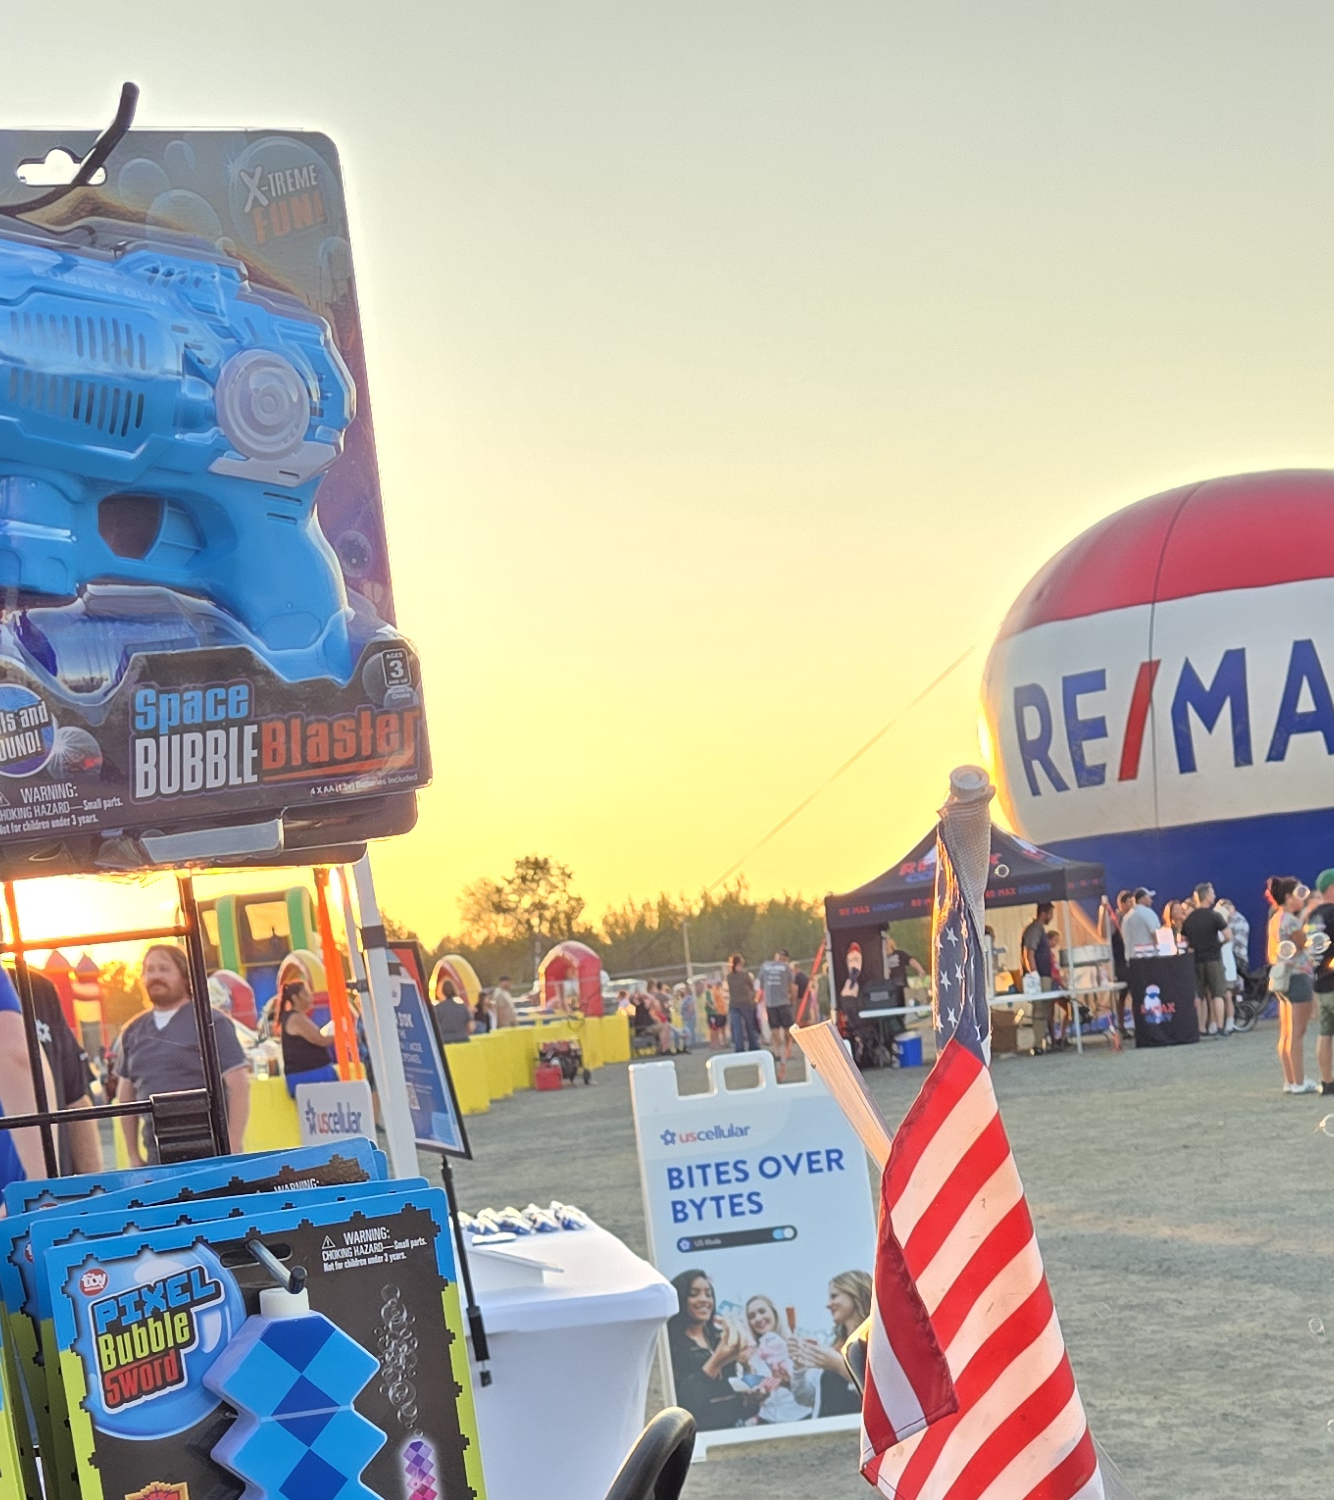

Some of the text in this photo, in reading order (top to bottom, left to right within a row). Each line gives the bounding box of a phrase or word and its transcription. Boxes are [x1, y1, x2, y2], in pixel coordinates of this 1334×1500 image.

[240, 165, 317, 212] X-TREME
[252, 191, 324, 246] FUN!
[390, 660, 404, 678] 3
[20, 701, 49, 728] and
[135, 684, 249, 735] Space
[20, 782, 78, 803] WARNING:
[324, 785, 335, 793] AA
[103, 797, 123, 810] parts.
[11, 821, 21, 832] for
[23, 817, 50, 831] children
[51, 815, 70, 828] under
[72, 815, 76, 825] 3
[78, 814, 99, 826] years.
[679, 1123, 751, 1144] uscellular
[666, 1148, 845, 1191] BITES OVER
[671, 1190, 764, 1224] BYTES
[343, 1226, 390, 1245] WARNING:
[322, 1237, 427, 1262] CHOKING parts.
[324, 1252, 406, 1272] Not for children under 3 years.
[81, 1274, 106, 1288] toy
[94, 1269, 216, 1334] PIXEL
[98, 1311, 190, 1372] Bubble
[104, 1349, 179, 1405] Sword
